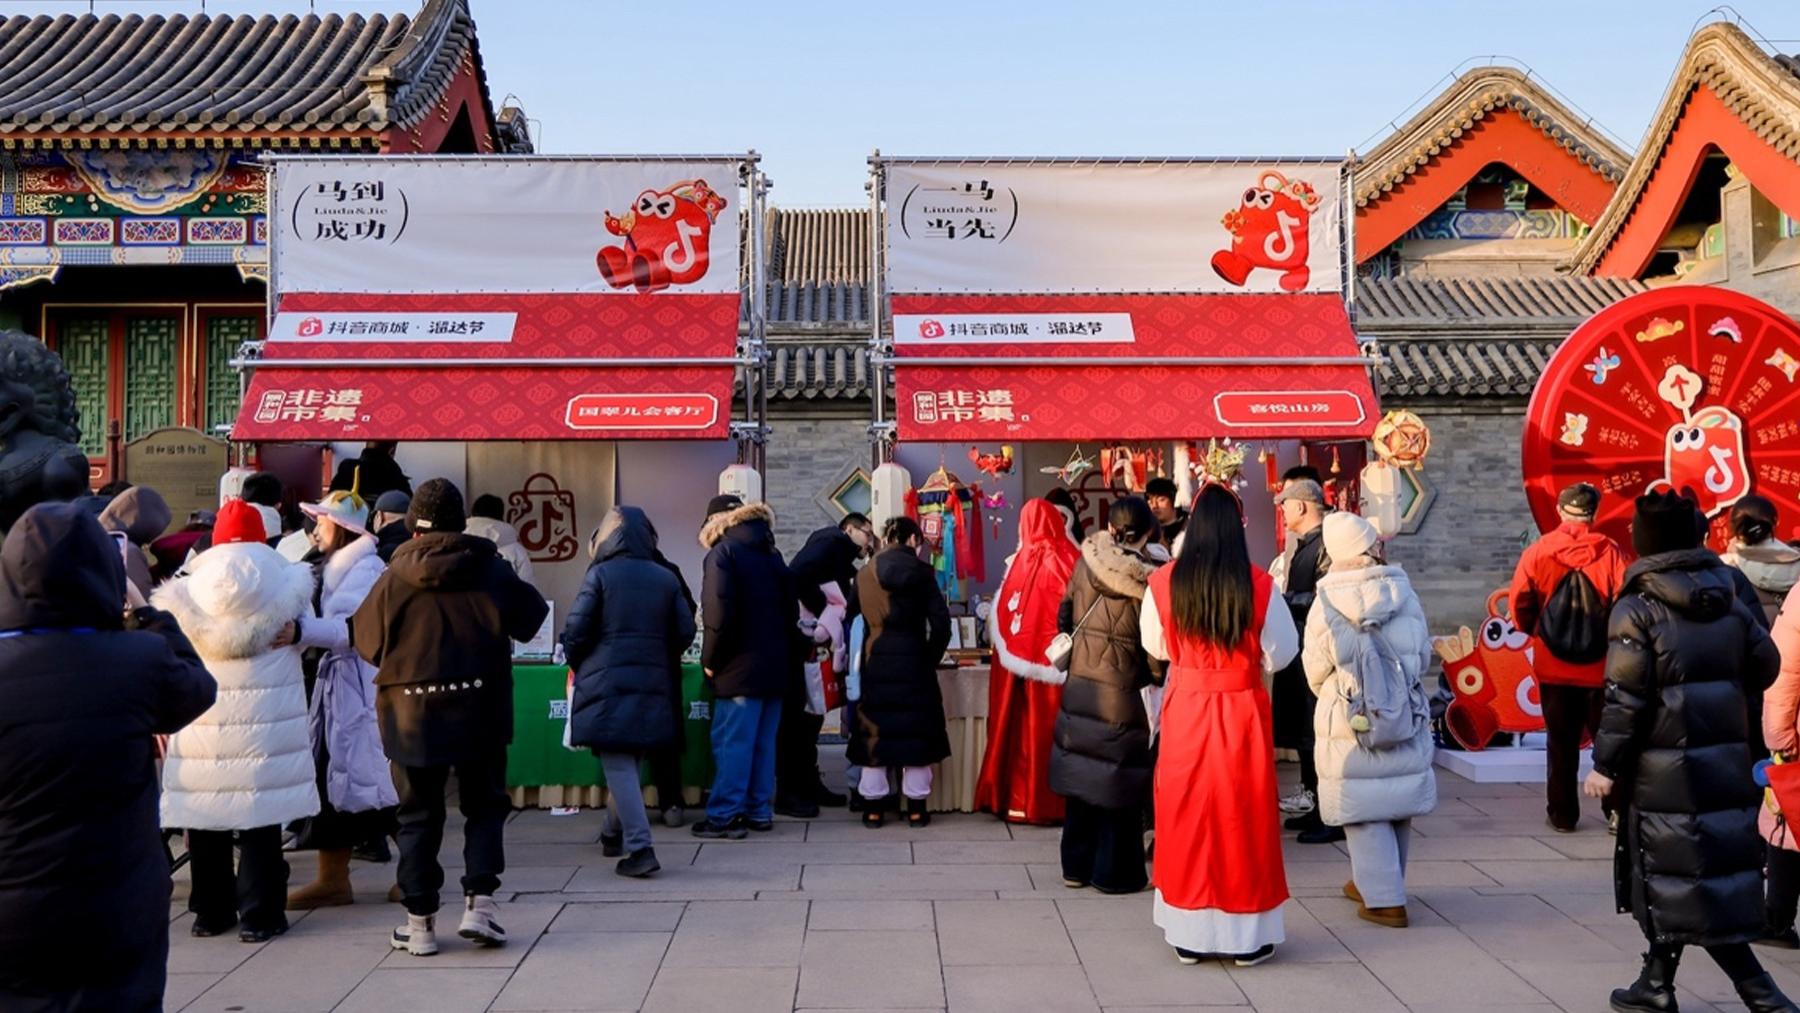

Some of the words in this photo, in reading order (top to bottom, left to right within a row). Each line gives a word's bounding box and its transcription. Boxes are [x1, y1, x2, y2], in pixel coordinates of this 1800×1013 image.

[315, 180, 384, 201] 马到
[922, 180, 994, 200] 一马
[315, 219, 386, 241] 成功
[924, 218, 996, 240] 当先
[285, 389, 363, 405] 非遗
[938, 389, 1014, 405] 非遗
